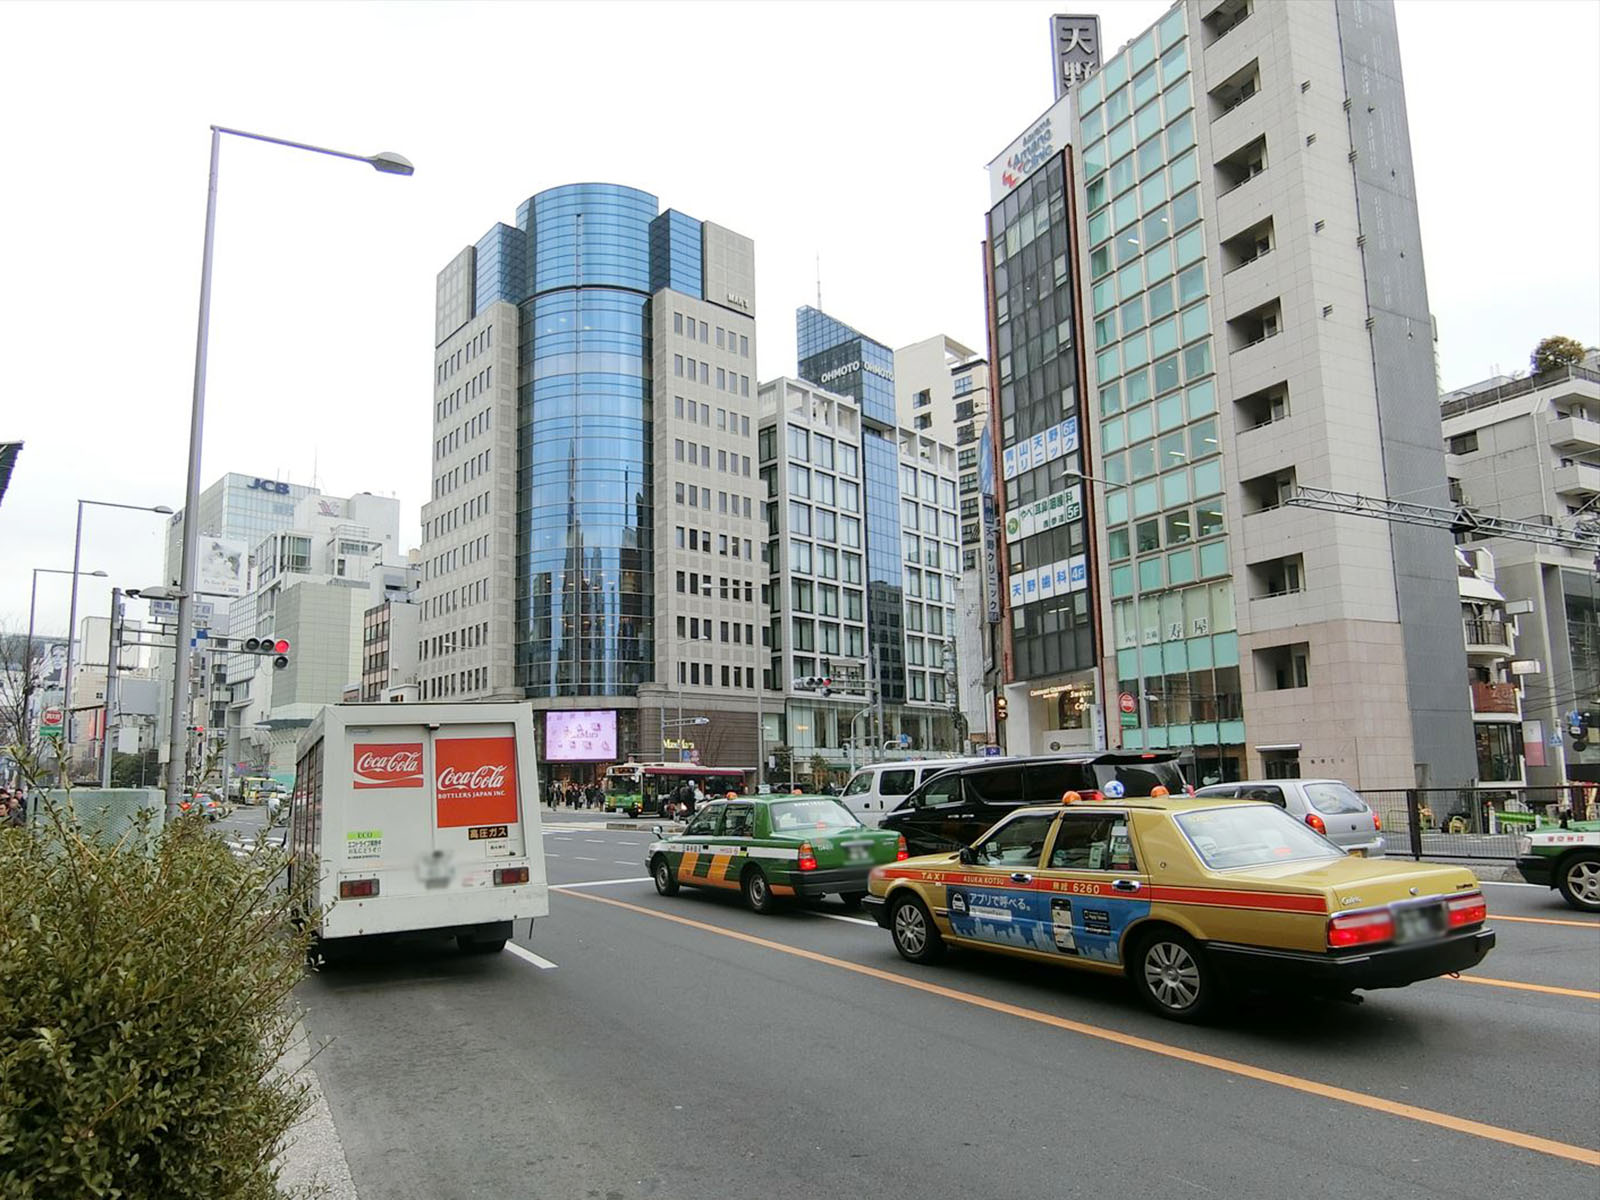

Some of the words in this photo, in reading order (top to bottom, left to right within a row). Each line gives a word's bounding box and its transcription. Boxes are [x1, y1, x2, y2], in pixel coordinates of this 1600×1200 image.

[821, 361, 860, 383] OHMOTO
[247, 478, 290, 495] JCB
[1067, 504, 1080, 519] 5F
[1072, 566, 1085, 580] 4F
[357, 752, 421, 773] Coca-Cola
[438, 765, 508, 791] Coca-Cola
[472, 790, 492, 798] JAPAN
[470, 828, 507, 839] 高圧ガス
[922, 872, 945, 881] TAXI
[1073, 883, 1100, 894] 6260
